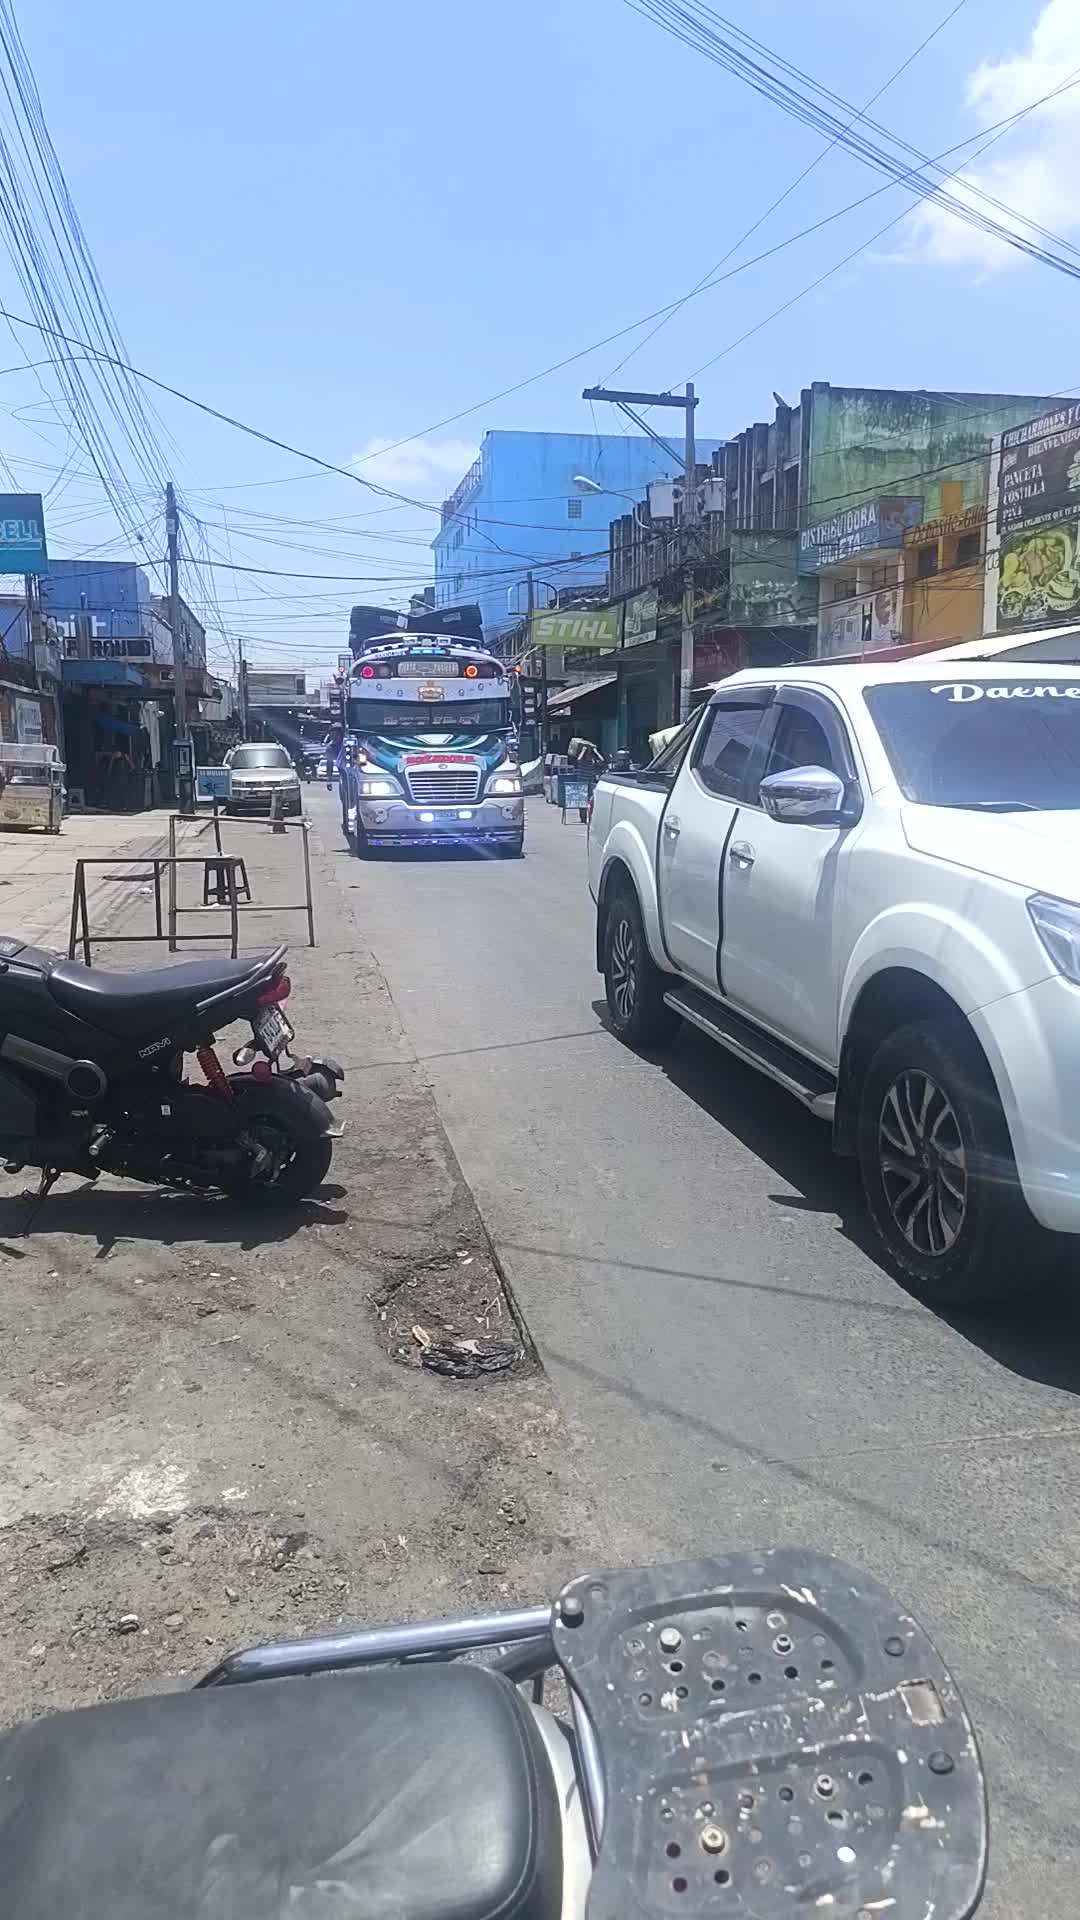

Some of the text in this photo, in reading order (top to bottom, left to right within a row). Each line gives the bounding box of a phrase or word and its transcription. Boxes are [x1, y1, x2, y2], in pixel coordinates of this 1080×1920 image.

[1003, 463, 1043, 489] PANCETA
[1003, 479, 1046, 505] COSTILLA
[801, 503, 876, 551] DISTRIBUIDORA
[536, 618, 613, 641] STIHL
[138, 1037, 172, 1059] NAVI
